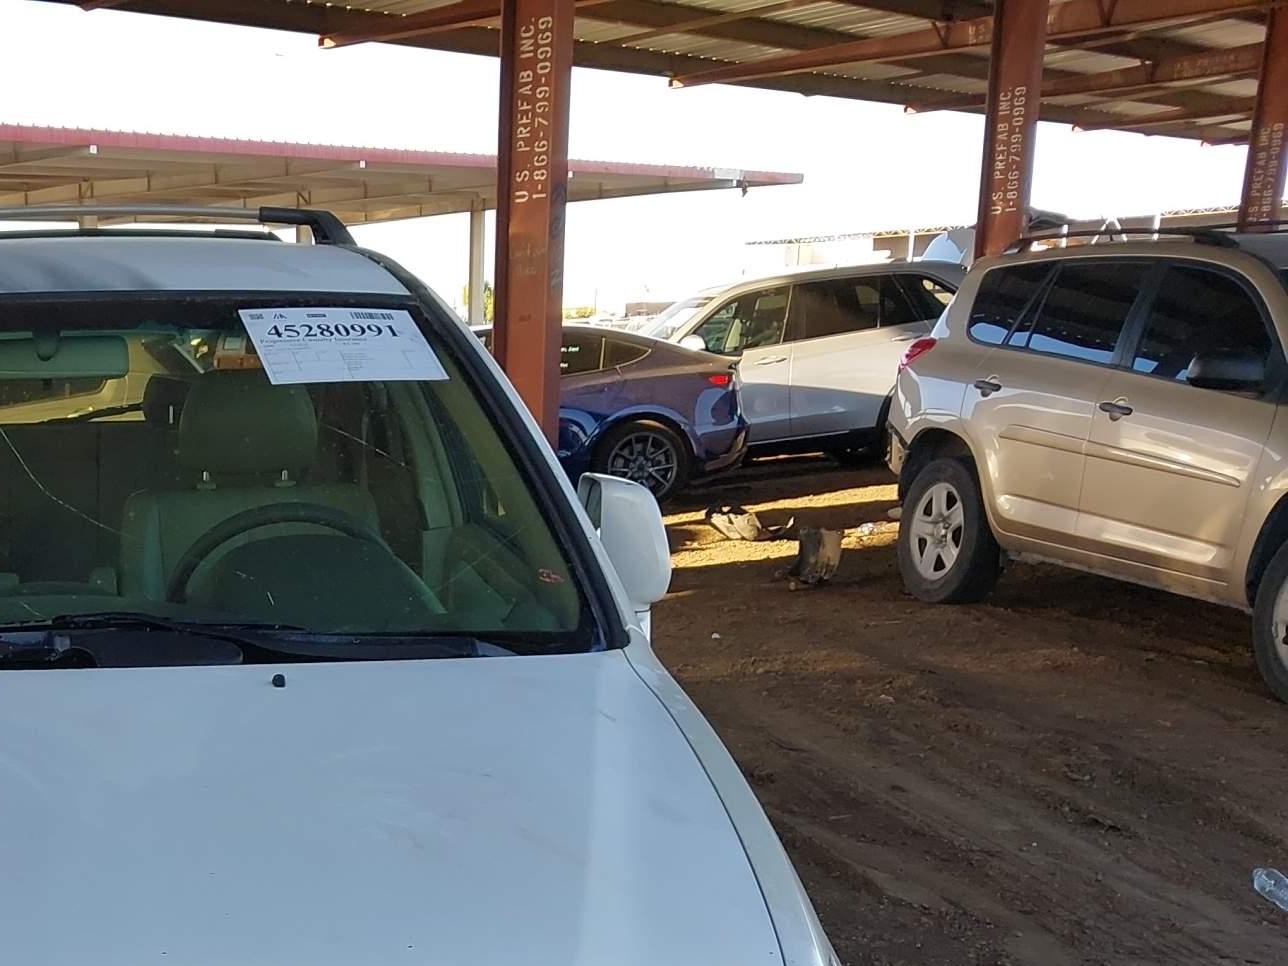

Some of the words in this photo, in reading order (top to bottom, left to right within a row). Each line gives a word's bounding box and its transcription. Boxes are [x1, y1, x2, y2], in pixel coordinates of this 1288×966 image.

[520, 17, 535, 58] INC.
[516, 69, 533, 151] PREFAB
[532, 16, 553, 199] 1-866-799-0969
[998, 86, 1013, 115] INC.
[994, 122, 1008, 179] PREFAB
[1005, 86, 1027, 212] 1-866-799-0969
[991, 186, 1004, 215] U.S.
[267, 322, 400, 339] 45280991
